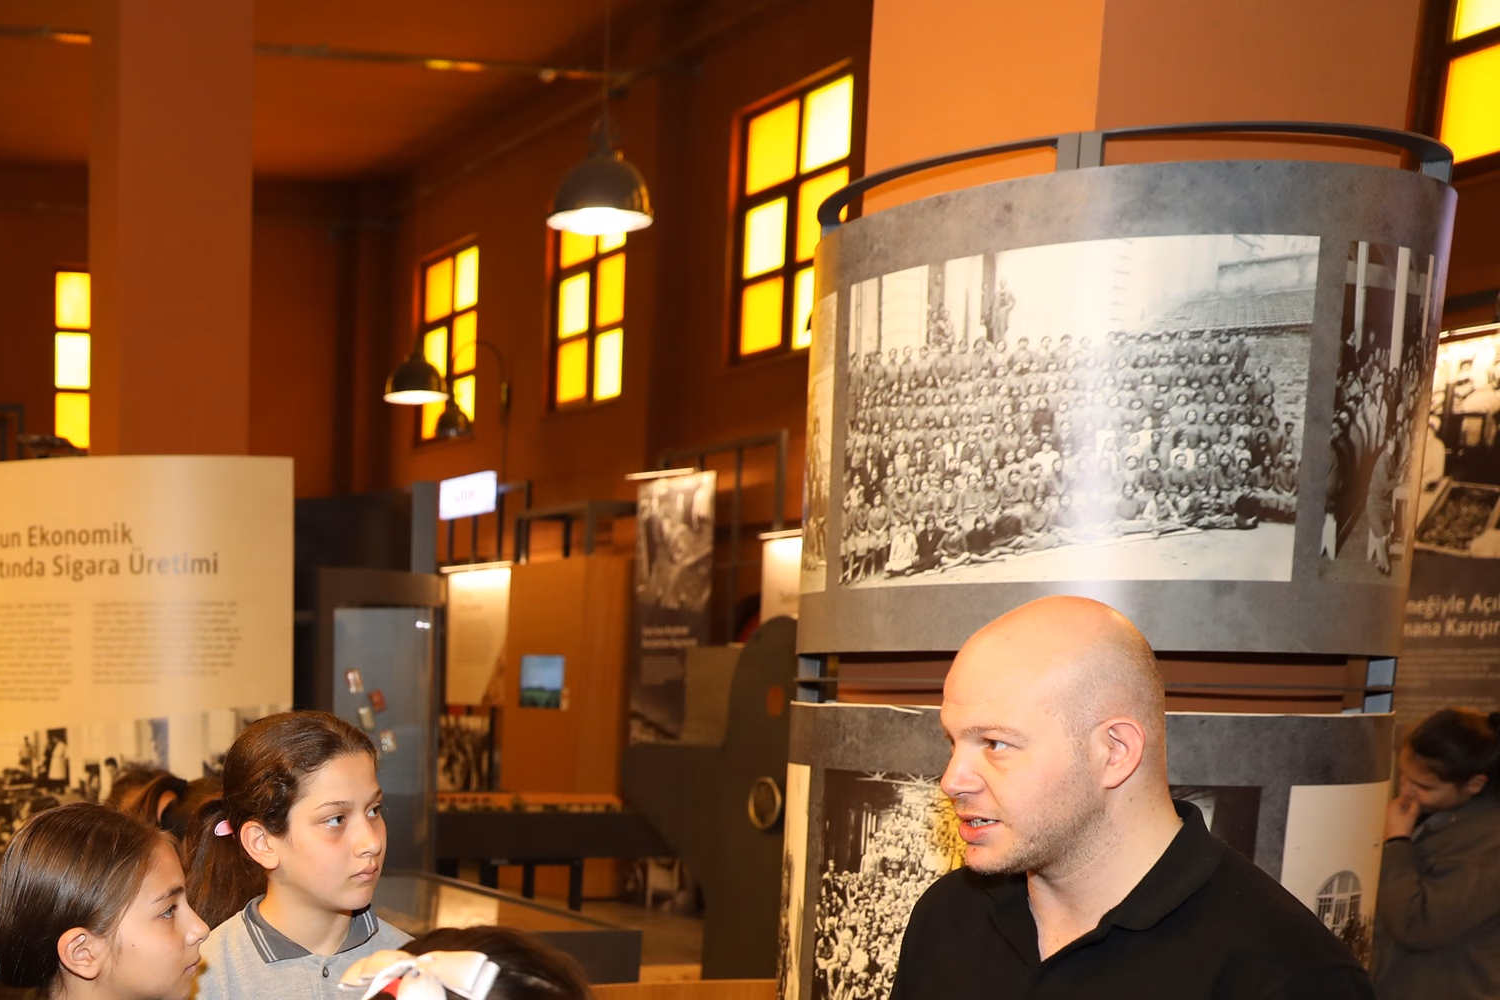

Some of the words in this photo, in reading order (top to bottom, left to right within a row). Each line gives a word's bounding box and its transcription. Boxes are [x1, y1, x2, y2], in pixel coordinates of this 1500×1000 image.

[28, 523, 134, 549] Ekonomik
[52, 554, 120, 582] Sigara
[129, 547, 219, 576] Üretimi
